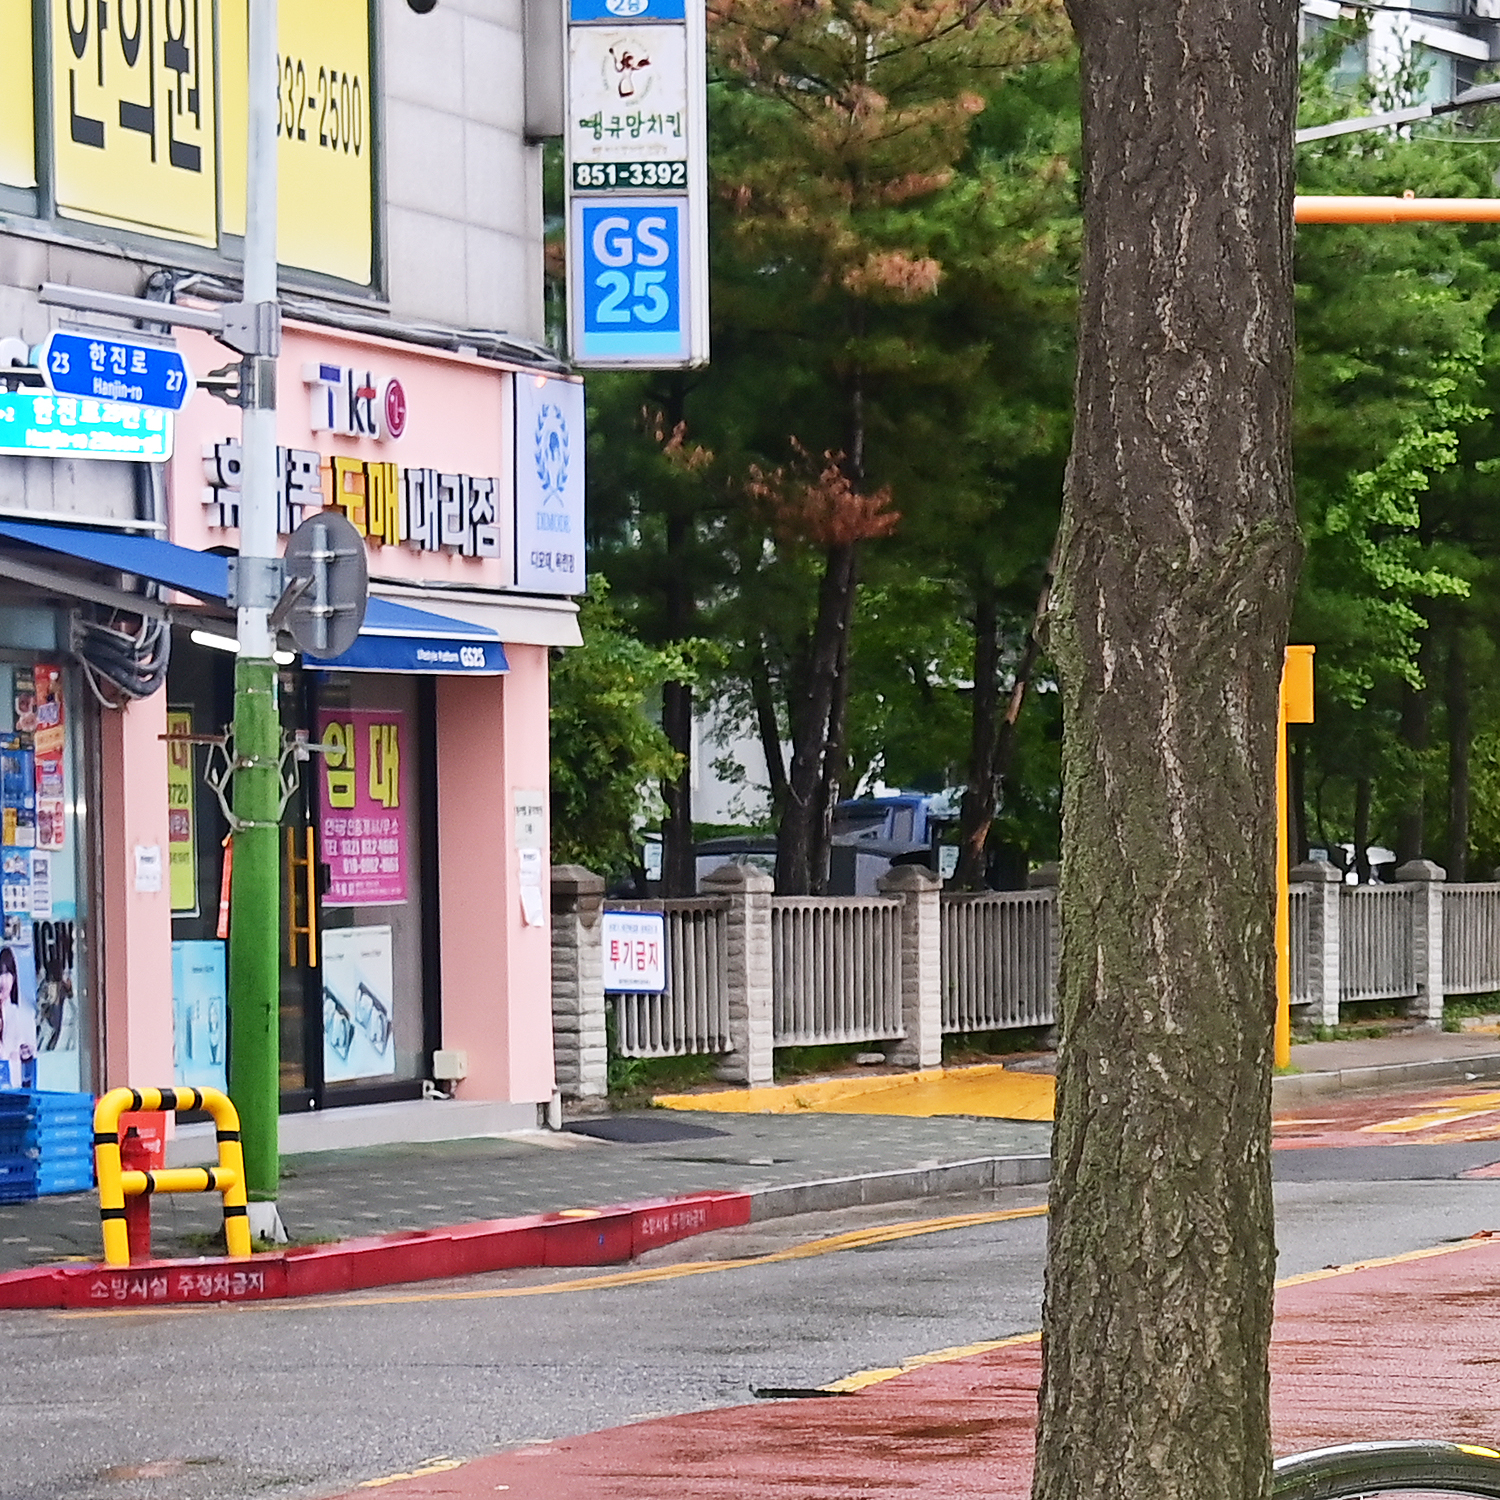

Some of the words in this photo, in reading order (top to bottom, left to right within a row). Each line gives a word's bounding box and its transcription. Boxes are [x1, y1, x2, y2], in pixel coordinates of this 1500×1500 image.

[576, 162, 686, 187] 851-3392
[592, 216, 671, 267] GS
[594, 269, 670, 324] 25
[51, 351, 70, 374] 23
[88, 341, 149, 375] 한진로
[165, 369, 184, 392] 27
[402, 466, 501, 559] 대리점
[609, 939, 659, 973] 투기금지
[90, 1275, 168, 1301] 소방시설
[177, 1271, 265, 1298] 주정차금지
